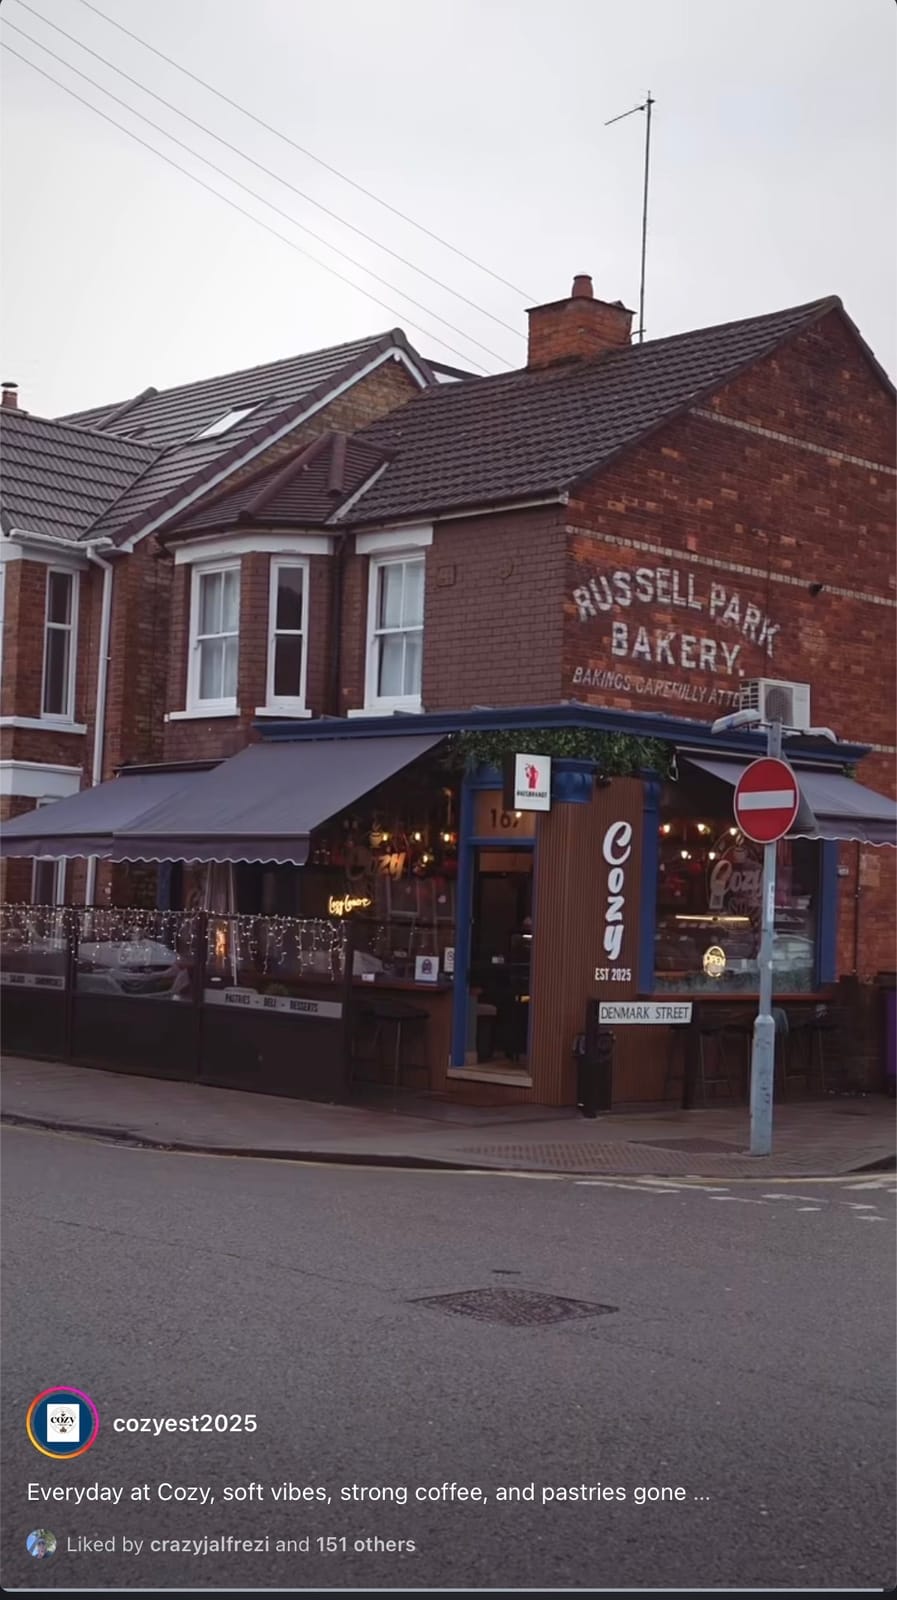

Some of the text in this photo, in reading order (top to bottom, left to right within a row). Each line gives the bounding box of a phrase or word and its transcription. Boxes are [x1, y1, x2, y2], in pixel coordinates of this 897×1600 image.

[572, 567, 781, 658] RUSSELL PARK
[611, 620, 745, 677] BAKERY.
[572, 666, 632, 692] BAKINGS
[635, 676, 707, 703] CAREFULLY
[602, 821, 633, 960] Cozy
[594, 968, 632, 982] EST 2025
[601, 1006, 689, 1020] DENMARK STREET
